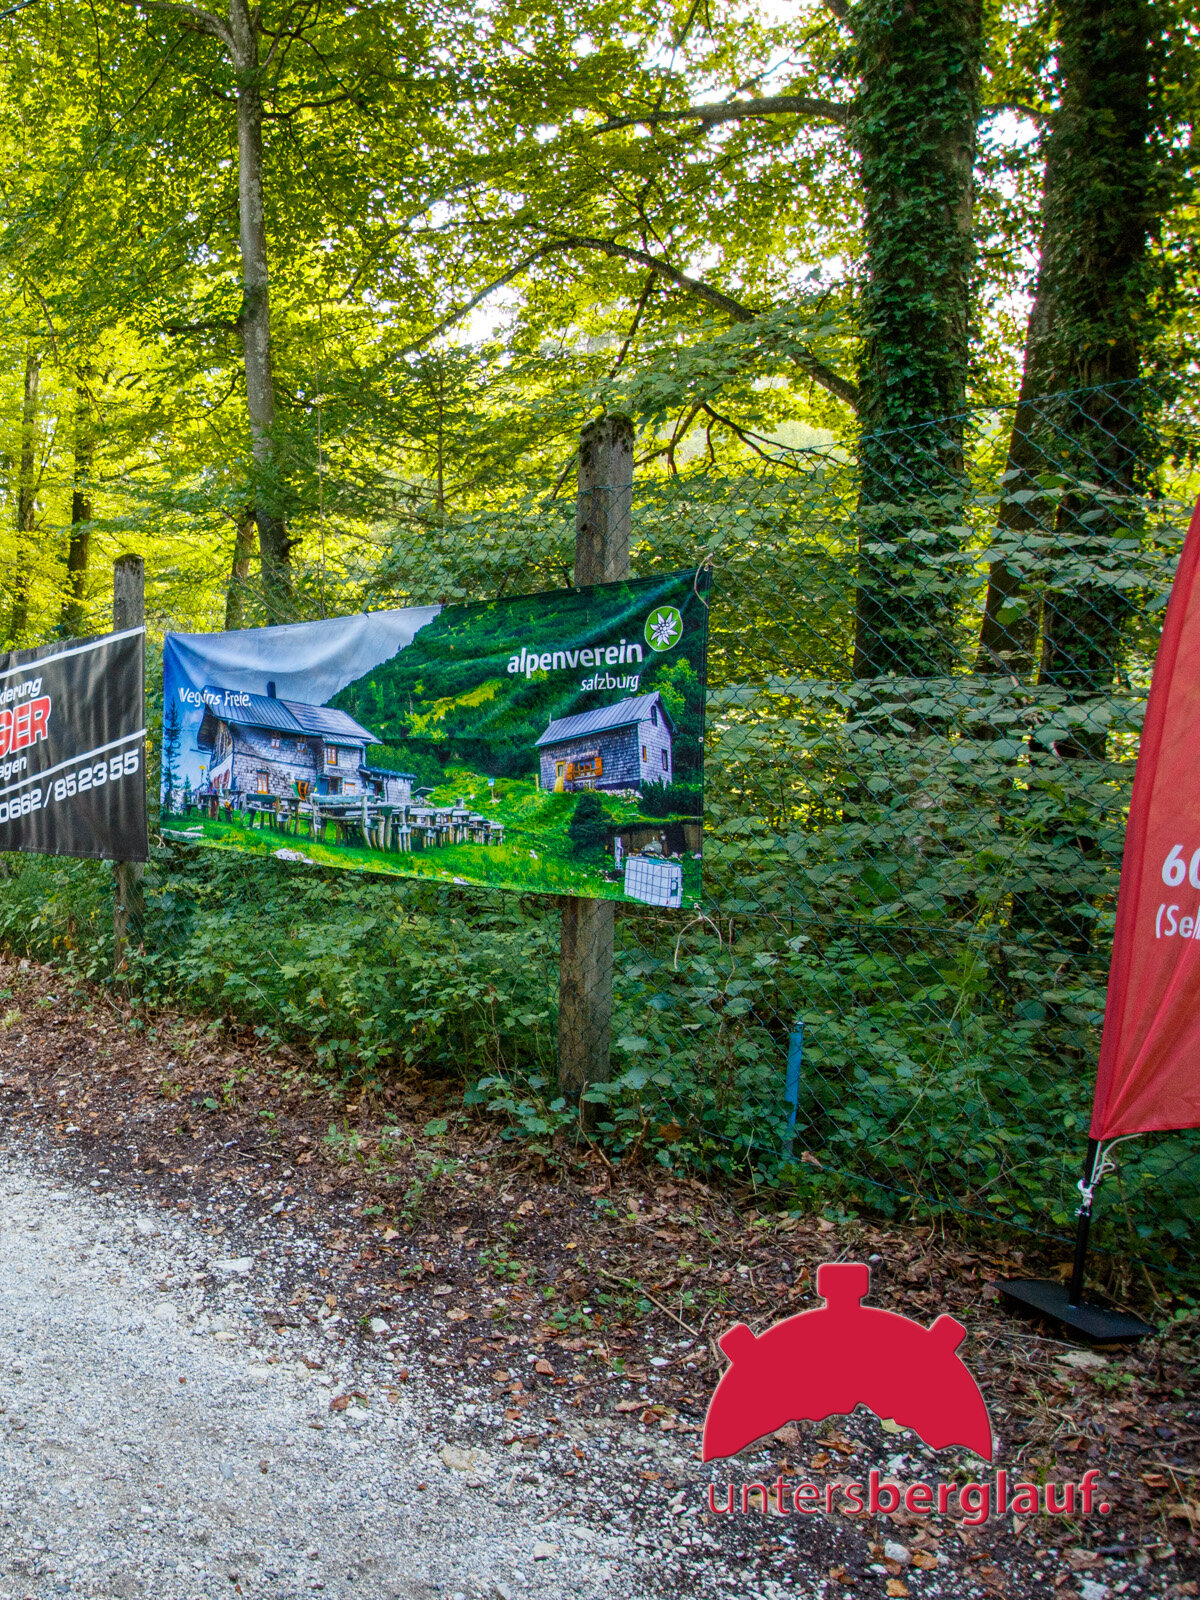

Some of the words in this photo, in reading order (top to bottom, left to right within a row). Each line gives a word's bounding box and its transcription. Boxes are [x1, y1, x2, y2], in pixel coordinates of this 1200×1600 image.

[507, 638, 643, 679] alpenverein
[580, 672, 640, 692] salzburg
[224, 690, 252, 707] Freie.
